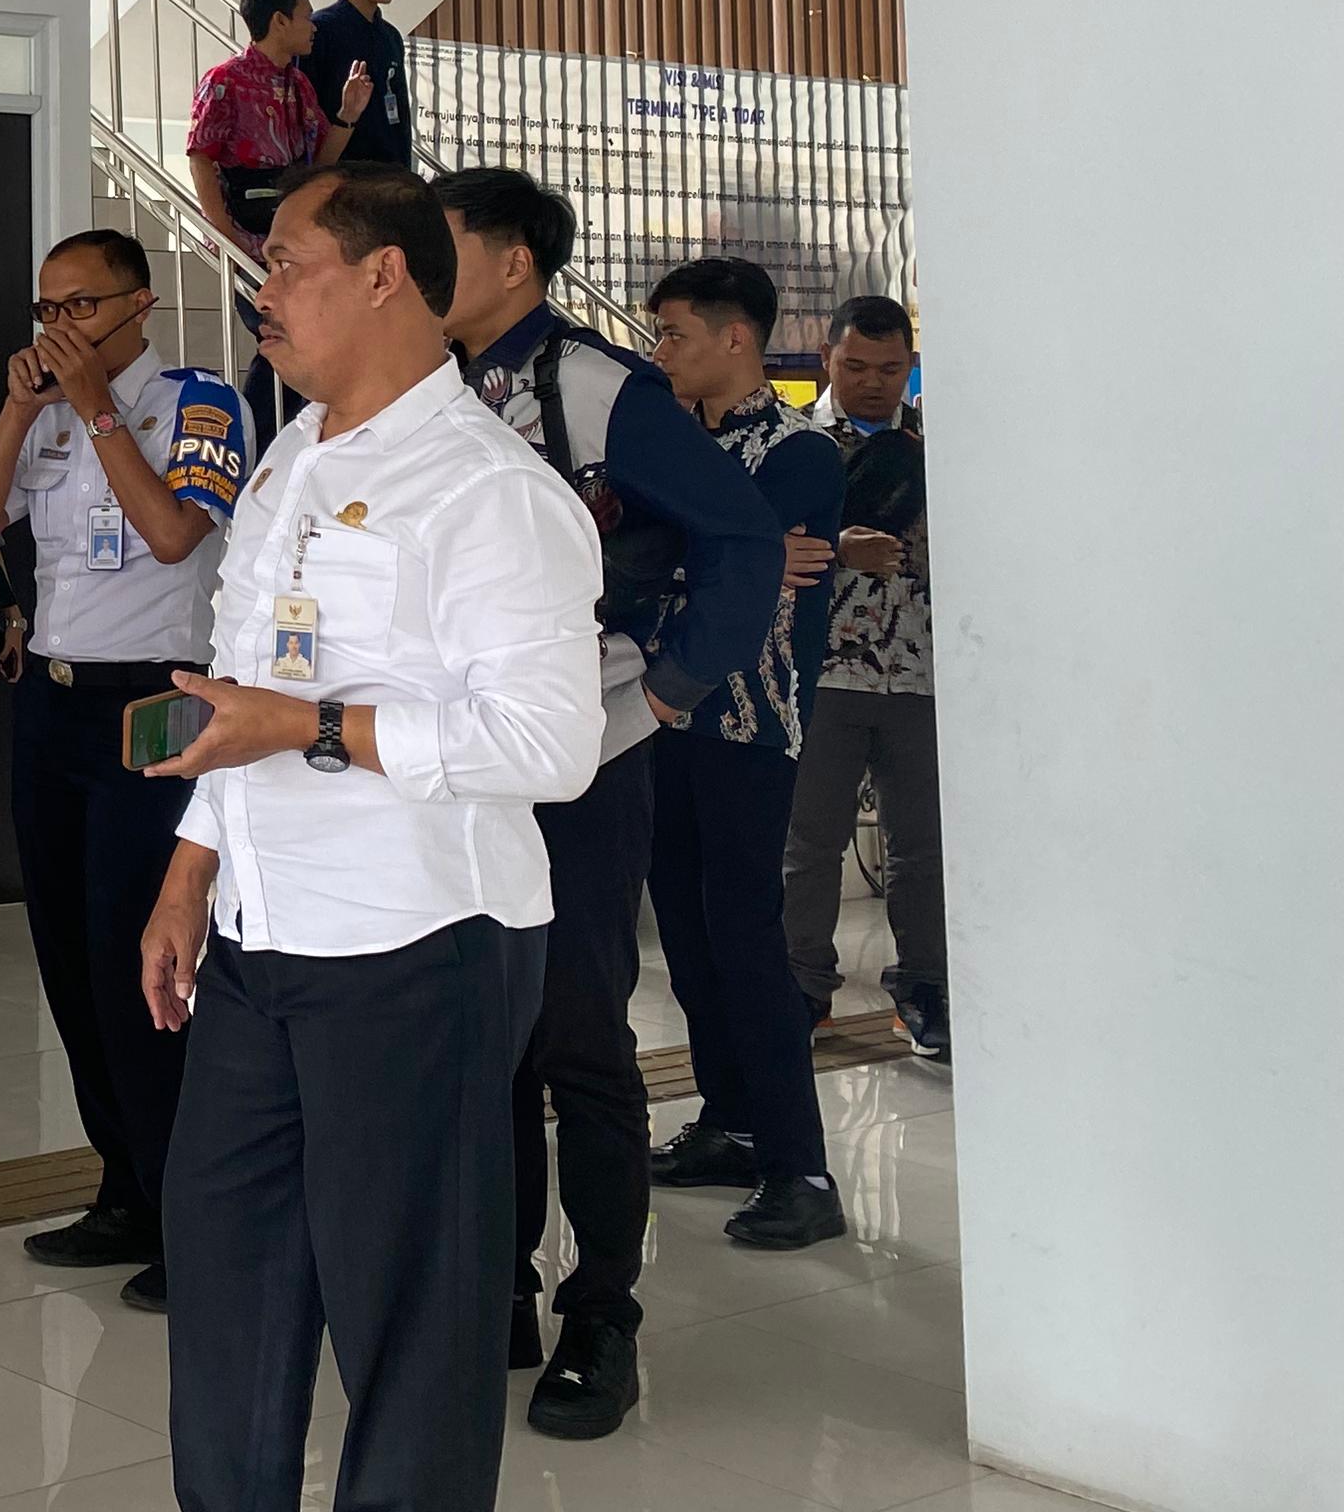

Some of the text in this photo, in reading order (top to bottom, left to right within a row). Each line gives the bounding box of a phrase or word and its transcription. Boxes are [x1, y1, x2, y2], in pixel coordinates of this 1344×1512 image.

[665, 69, 686, 88] VISI
[699, 73, 724, 90] MISI
[627, 98, 766, 125] TERMINAL TIPE A TIDAR
[479, 112, 519, 126] Terminal
[551, 119, 575, 131] Tidar
[466, 135, 484, 147] dan
[591, 276, 622, 290] ebagai
